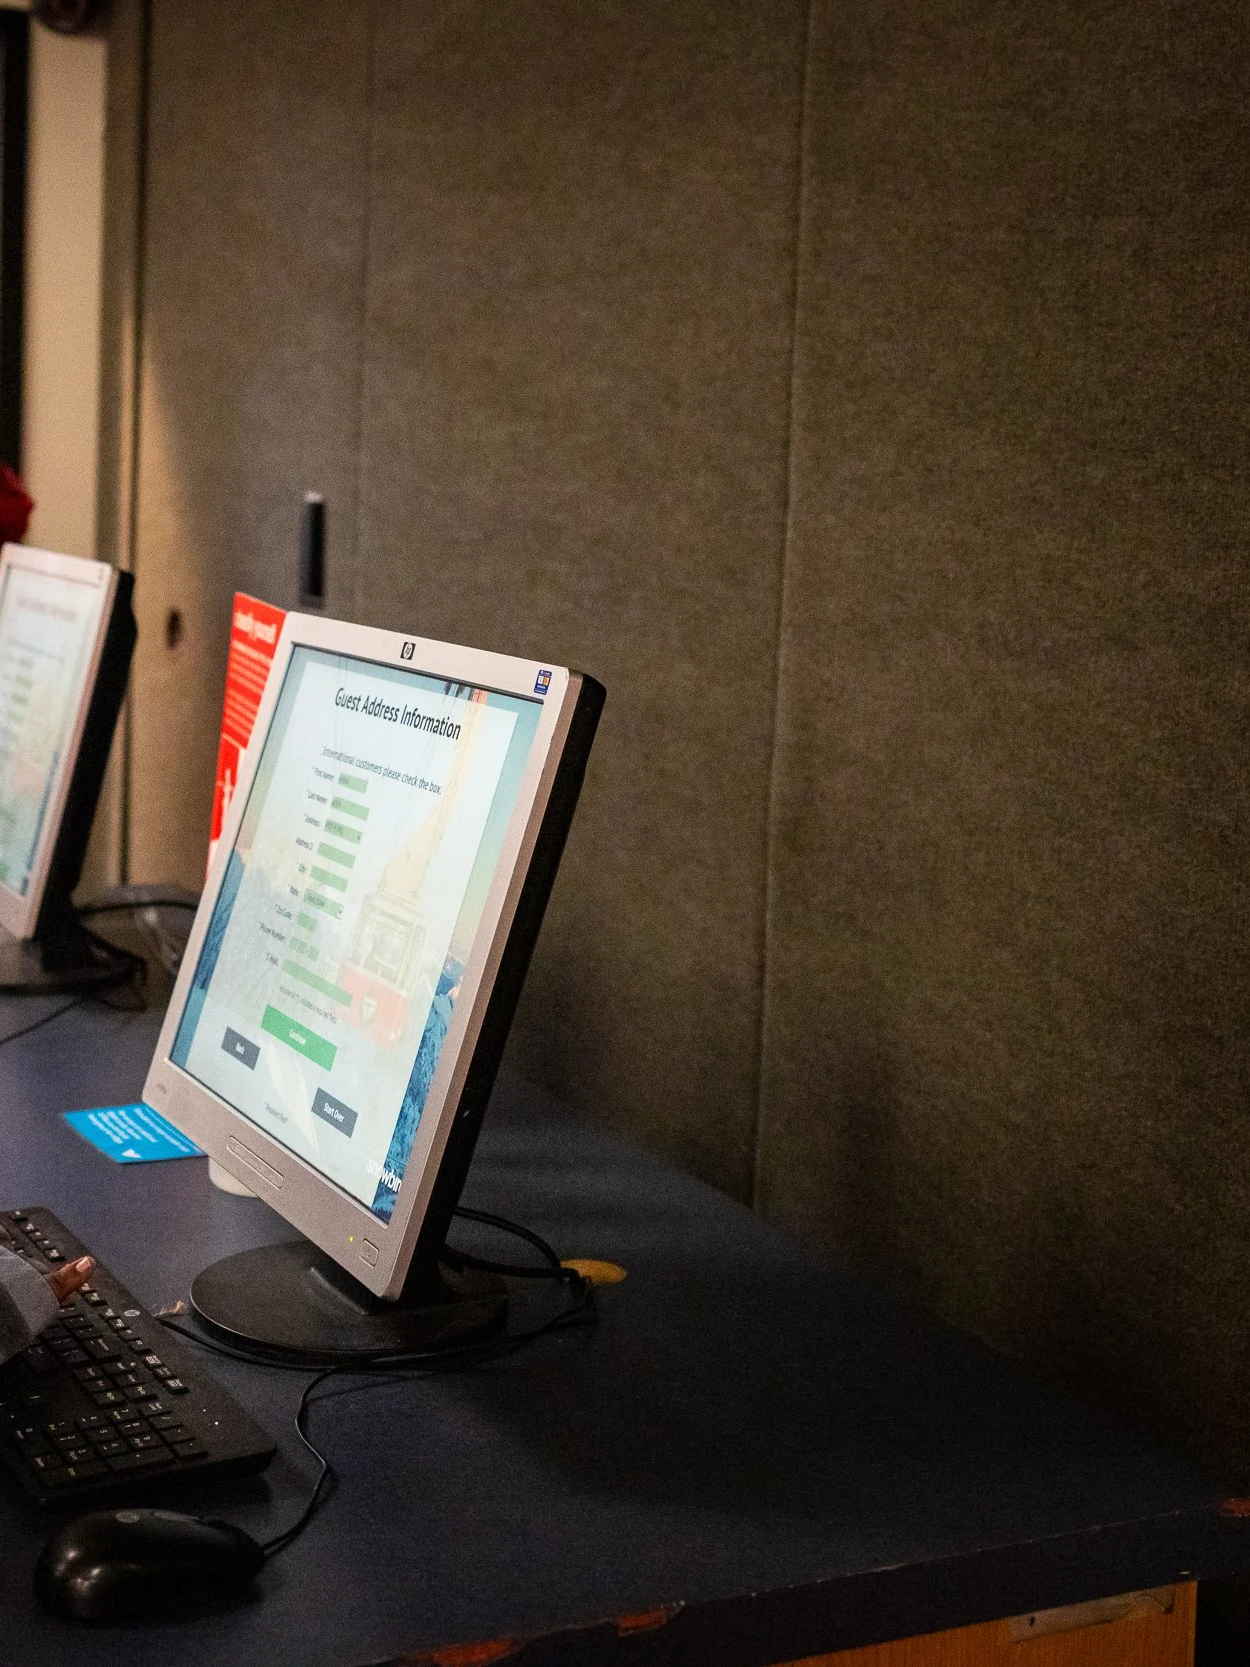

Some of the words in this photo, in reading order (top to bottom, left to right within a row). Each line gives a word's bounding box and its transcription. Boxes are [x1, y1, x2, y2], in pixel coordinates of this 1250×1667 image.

[335, 687, 361, 712] Guest
[361, 695, 400, 722] Address
[400, 705, 461, 740] Information
[355, 755, 382, 775] customers
[381, 763, 401, 781] please
[401, 769, 418, 787] check
[419, 774, 429, 790] the
[429, 780, 442, 795] box.
[323, 1102, 335, 1117] Start
[333, 1109, 345, 1123] Over
